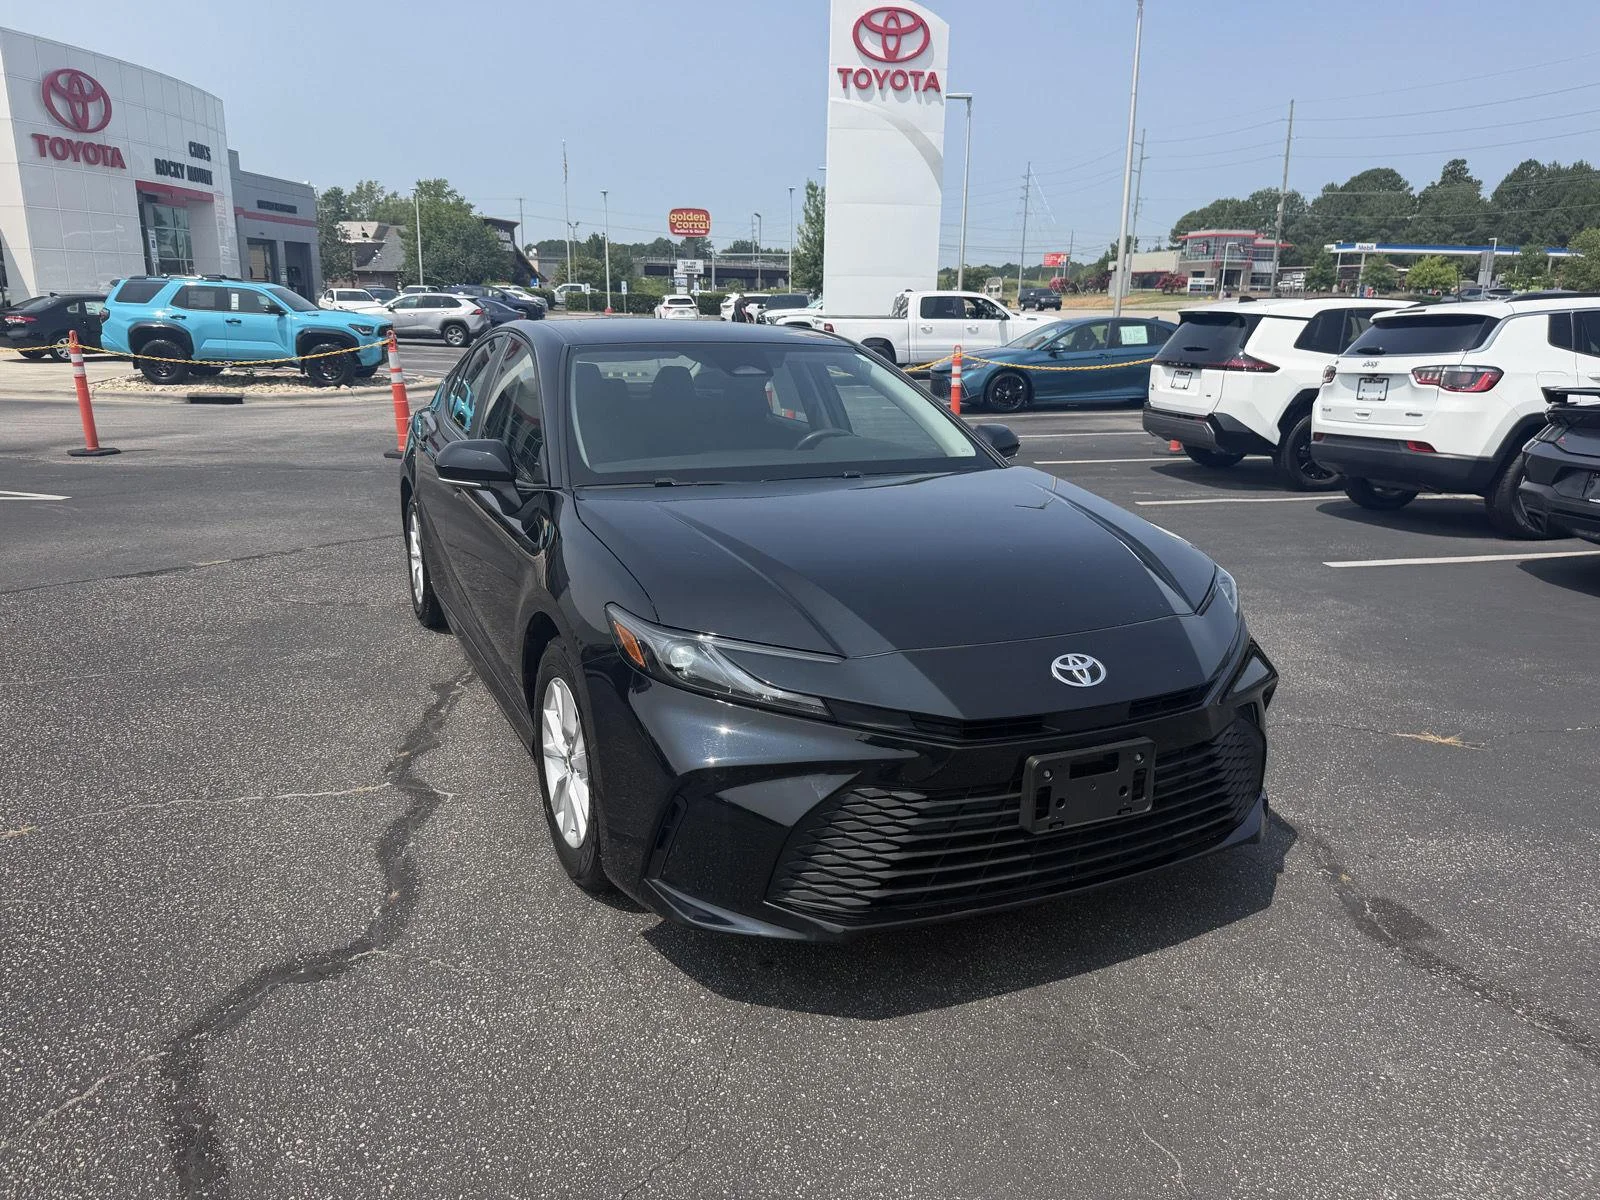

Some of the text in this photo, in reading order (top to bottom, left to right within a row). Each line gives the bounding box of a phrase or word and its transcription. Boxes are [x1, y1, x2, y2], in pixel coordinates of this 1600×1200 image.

[837, 68, 941, 92] TOYOTA
[31, 133, 127, 169] TOYOTA
[154, 157, 185, 180] ROCKY
[670, 212, 706, 223] golden
[676, 220, 710, 229] corral
